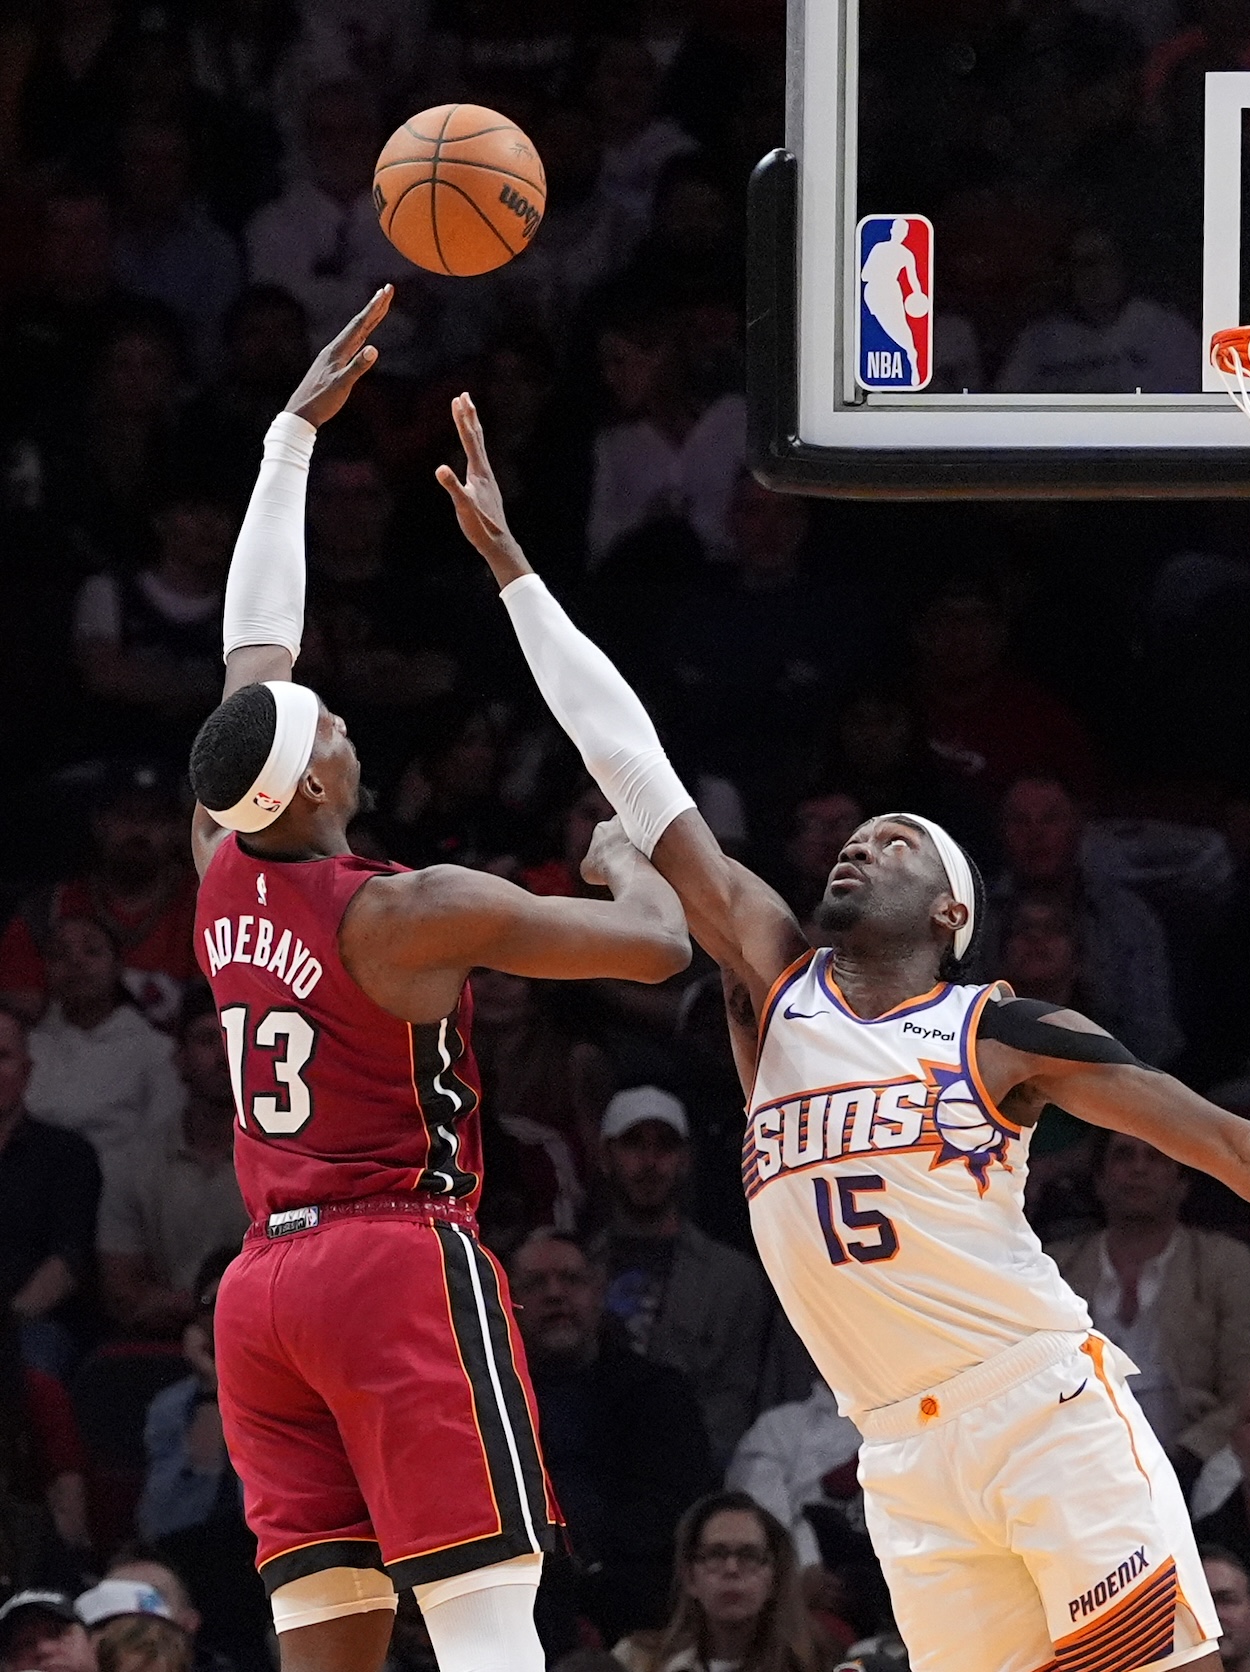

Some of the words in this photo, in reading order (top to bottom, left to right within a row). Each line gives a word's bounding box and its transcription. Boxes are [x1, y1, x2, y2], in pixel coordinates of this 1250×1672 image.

[867, 351, 903, 379] NBA
[204, 914, 323, 1000] ADEBAYO
[219, 1003, 316, 1138] 13
[903, 1021, 956, 1041] PayPal
[754, 1082, 928, 1181] SUNS
[811, 1174, 900, 1266] 15
[1068, 1544, 1150, 1623] PHOENIX
